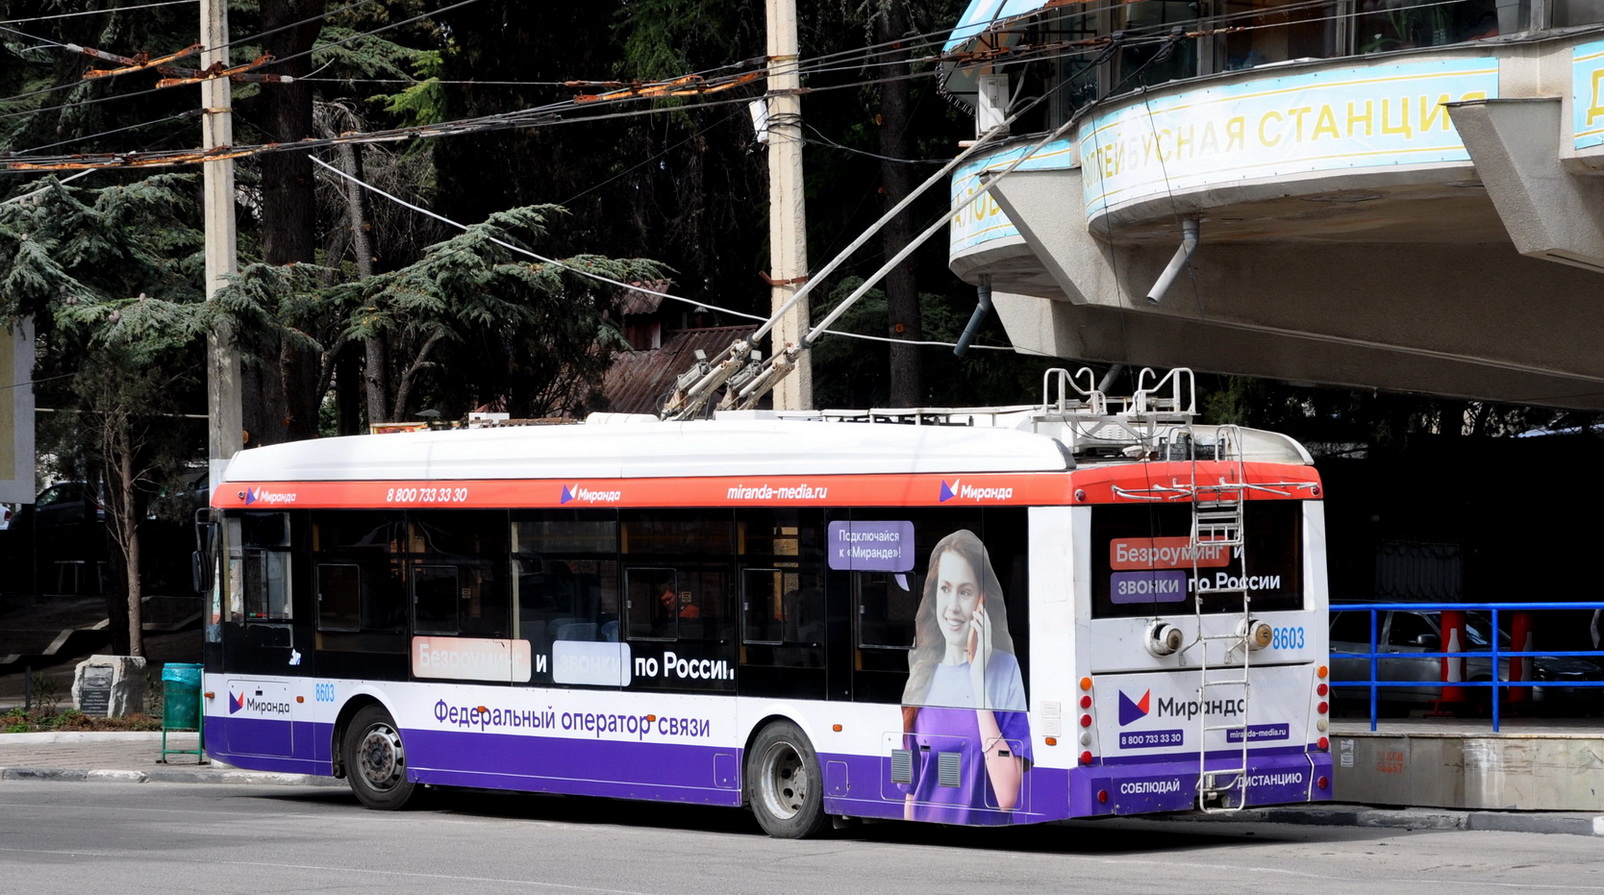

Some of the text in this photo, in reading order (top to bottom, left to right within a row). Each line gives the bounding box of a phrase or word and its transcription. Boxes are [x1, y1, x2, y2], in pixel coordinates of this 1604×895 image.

[1258, 91, 1486, 148] СТАНЦИ
[259, 490, 297, 503] Миранда
[386, 487, 467, 502] 8 800 733 33 30
[577, 488, 621, 504] Миранда
[726, 484, 828, 500] miranda-media.ru
[960, 484, 1013, 500] Миранда
[839, 529, 900, 543] Подключайся
[839, 548, 845, 558] к
[1116, 543, 1223, 566] Безроуминг
[1118, 578, 1179, 595] звонки
[1216, 572, 1280, 591] России
[1273, 626, 1305, 650] 8603
[536, 654, 546, 673] и
[635, 657, 658, 676] по
[315, 683, 335, 702] 8603
[247, 697, 290, 714] Миранда
[434, 699, 711, 740] Федеральный оператор связи
[1121, 733, 1182, 745] 8 800 733 33 30
[1230, 728, 1287, 739] mirada-media.ru
[1120, 772, 1302, 794] СОБЛЮДАЙ ДИСТАНЦИЮ
